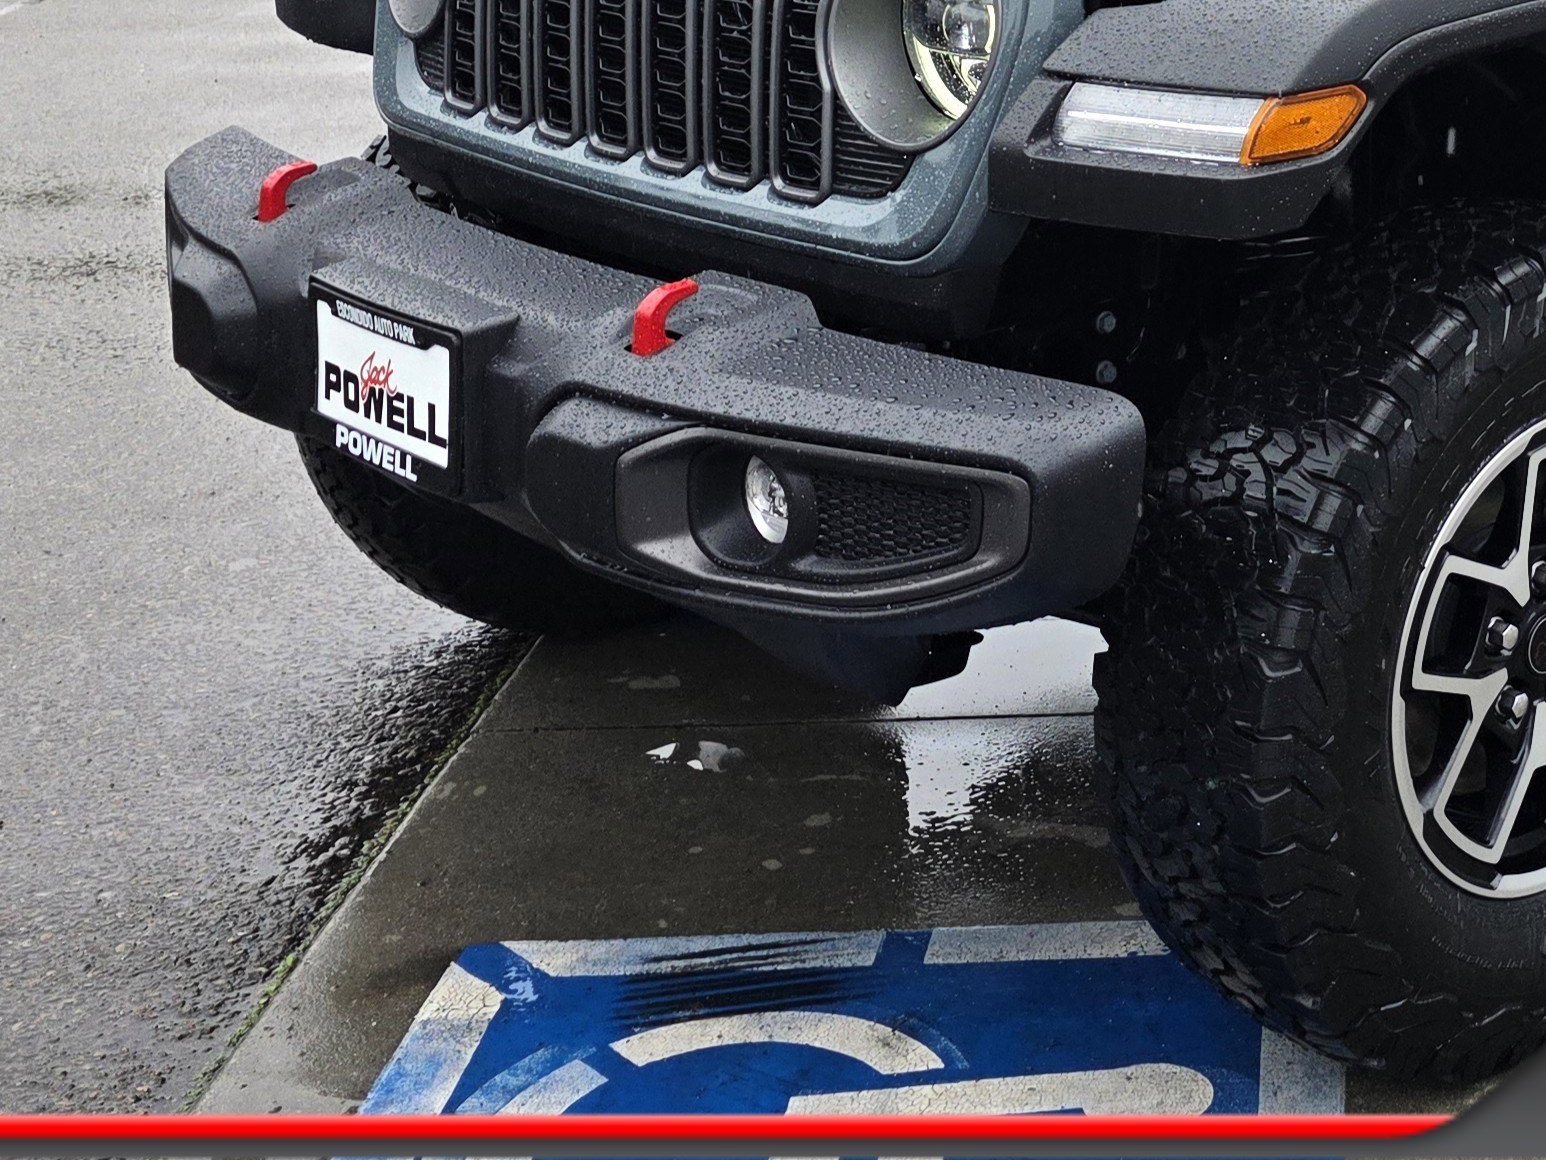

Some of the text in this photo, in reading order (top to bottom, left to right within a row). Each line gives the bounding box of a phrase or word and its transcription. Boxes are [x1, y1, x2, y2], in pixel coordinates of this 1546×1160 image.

[373, 315, 394, 338] AUTO
[393, 321, 416, 345] PARK
[325, 360, 448, 449] POWELL
[360, 351, 398, 403] Jack
[335, 423, 418, 482] POWELL
